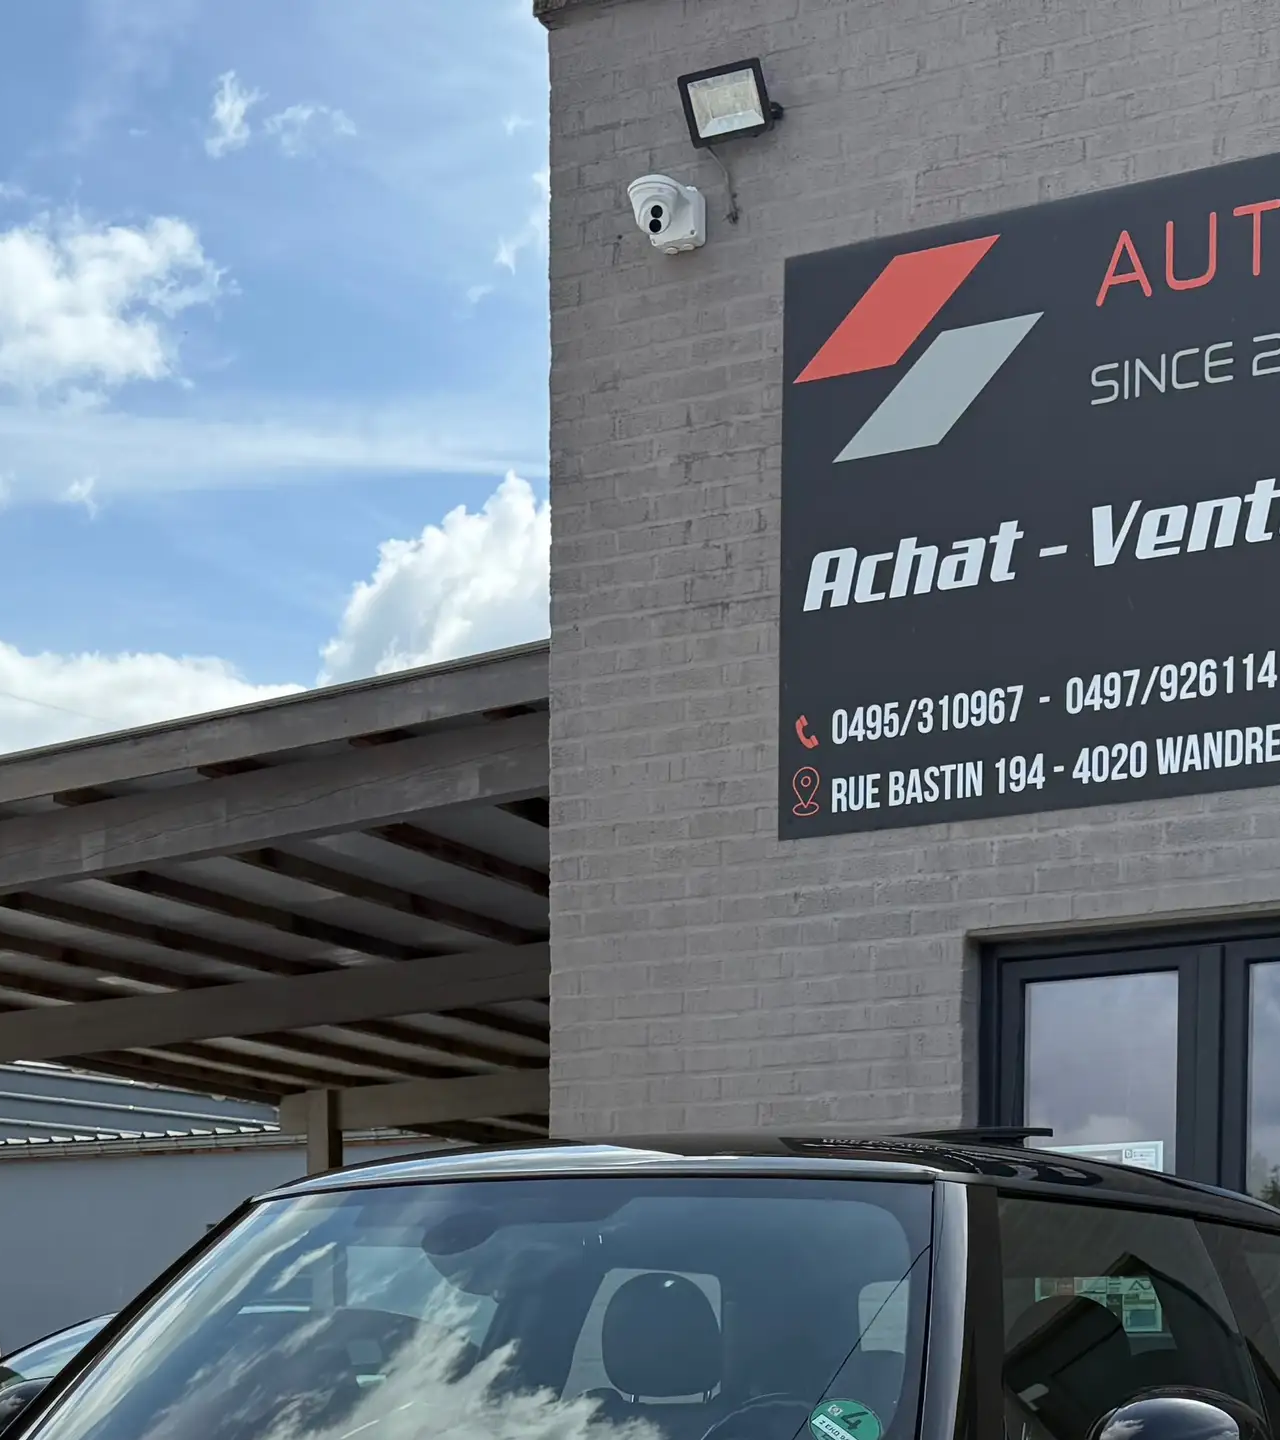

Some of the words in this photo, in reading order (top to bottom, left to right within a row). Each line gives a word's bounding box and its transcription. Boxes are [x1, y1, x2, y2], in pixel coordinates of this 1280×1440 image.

[1090, 340, 1233, 406] SINCE
[802, 520, 1024, 612] Achat
[1039, 544, 1068, 558] -
[831, 685, 1024, 745] 0495/310967
[1065, 650, 1278, 715] 0497/926114
[831, 773, 881, 813] RUE
[888, 760, 984, 807] BASTIN
[994, 753, 1046, 794] 194
[1072, 740, 1148, 784] 4020
[840, 1411, 869, 1430] 4
